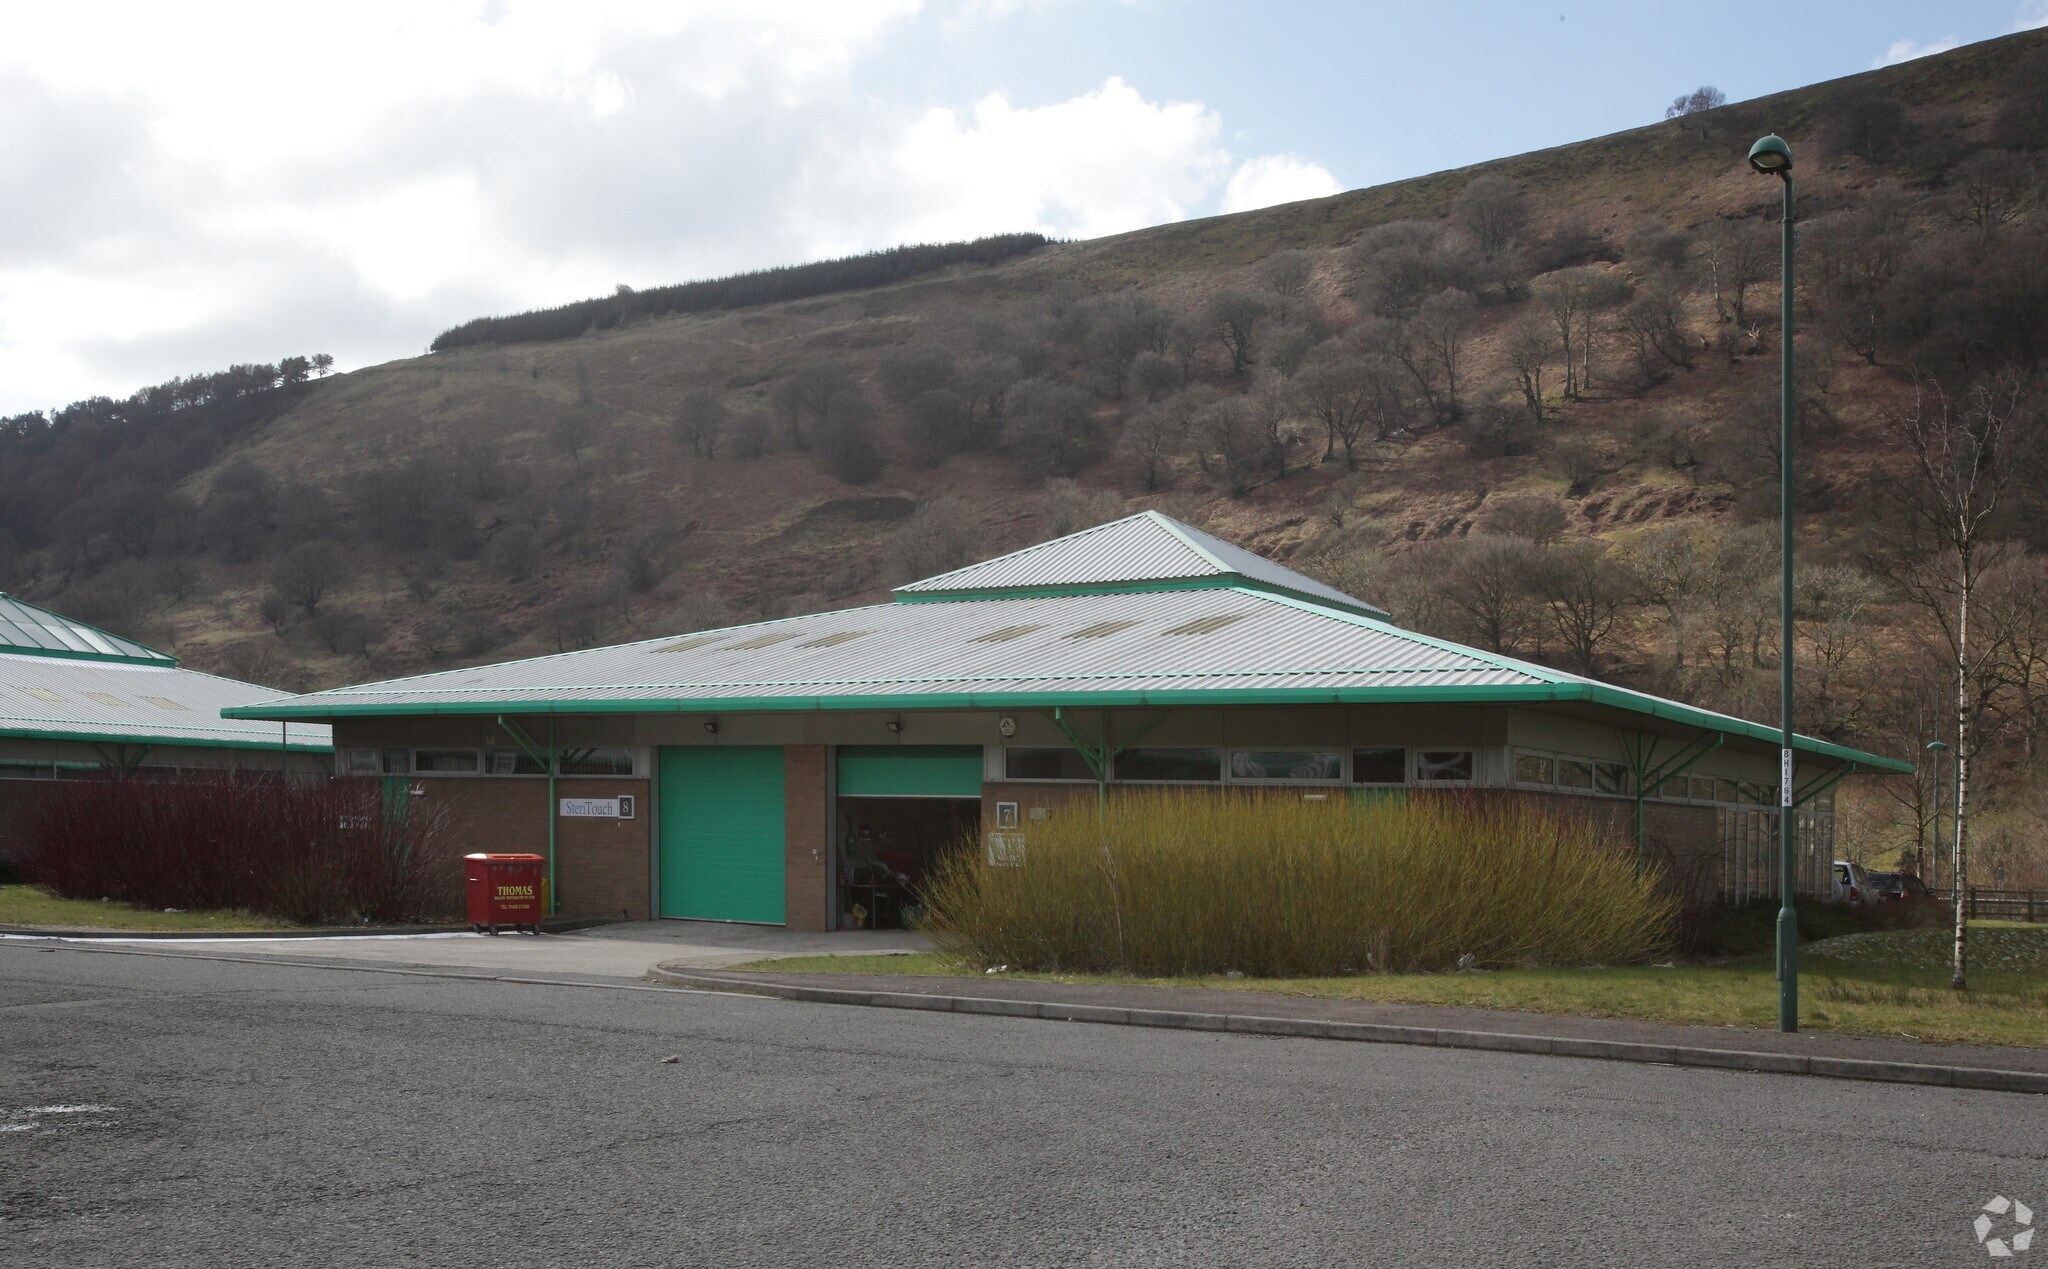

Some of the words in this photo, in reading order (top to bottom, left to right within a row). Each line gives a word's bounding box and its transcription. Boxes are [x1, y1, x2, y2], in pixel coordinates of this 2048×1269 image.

[566, 801, 613, 815] SteriTouch
[622, 801, 629, 813] 8
[1004, 809, 1010, 822] 7
[497, 886, 533, 895] THOMAS
